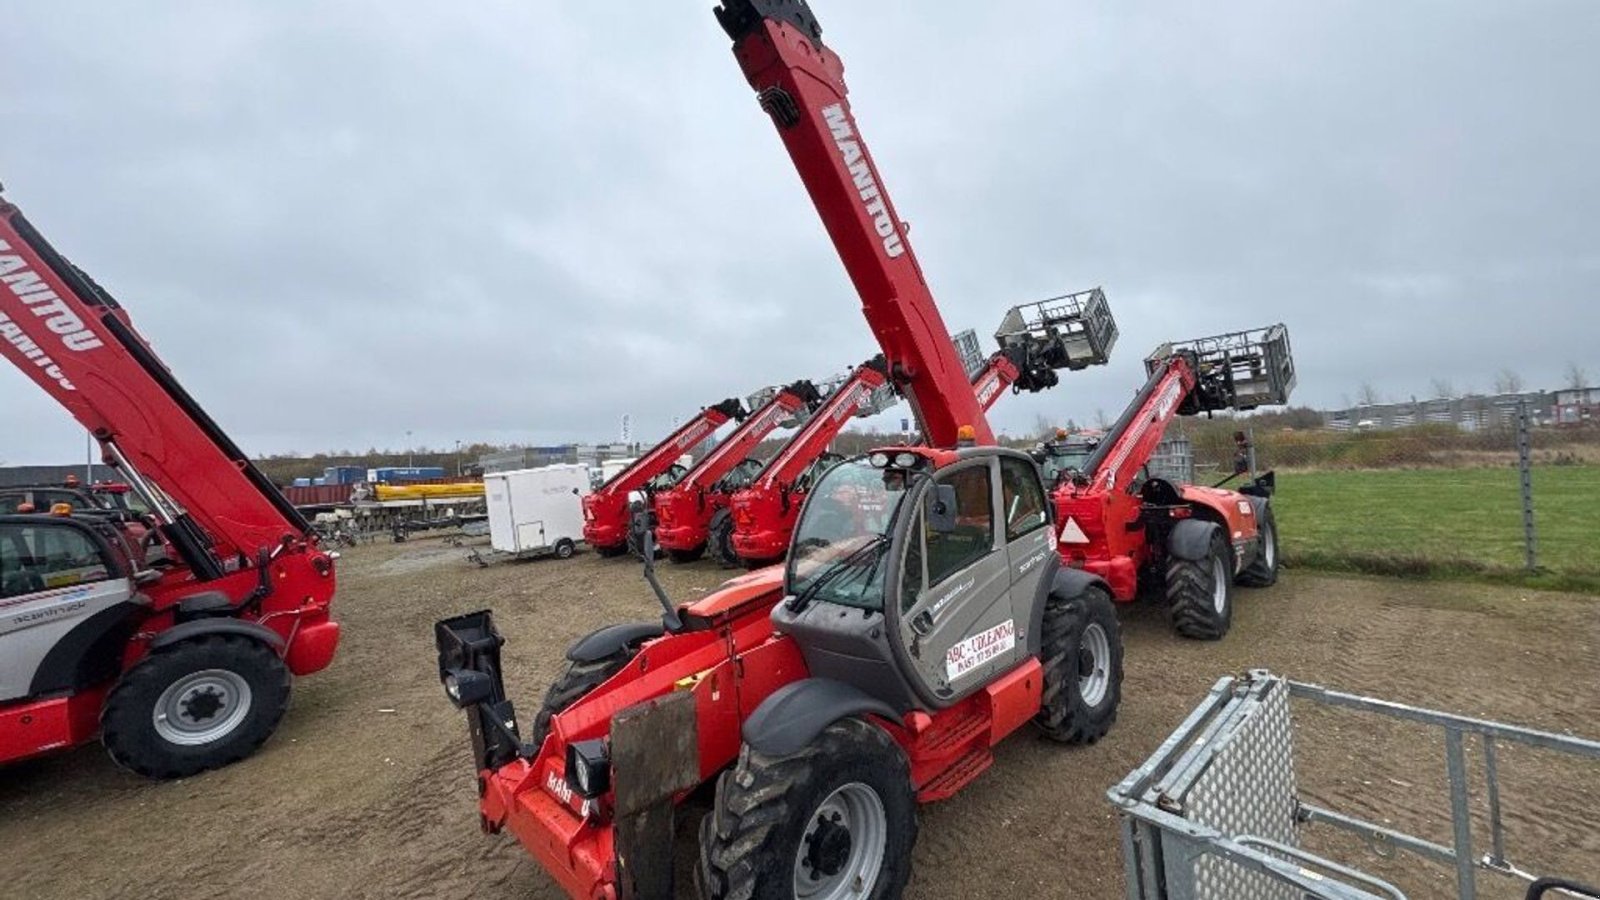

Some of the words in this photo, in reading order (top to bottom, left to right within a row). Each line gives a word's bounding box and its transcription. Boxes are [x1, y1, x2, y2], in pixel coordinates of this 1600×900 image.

[822, 103, 905, 258] MANITOU
[0, 239, 105, 352] ANITOU
[947, 644, 966, 665] ABC
